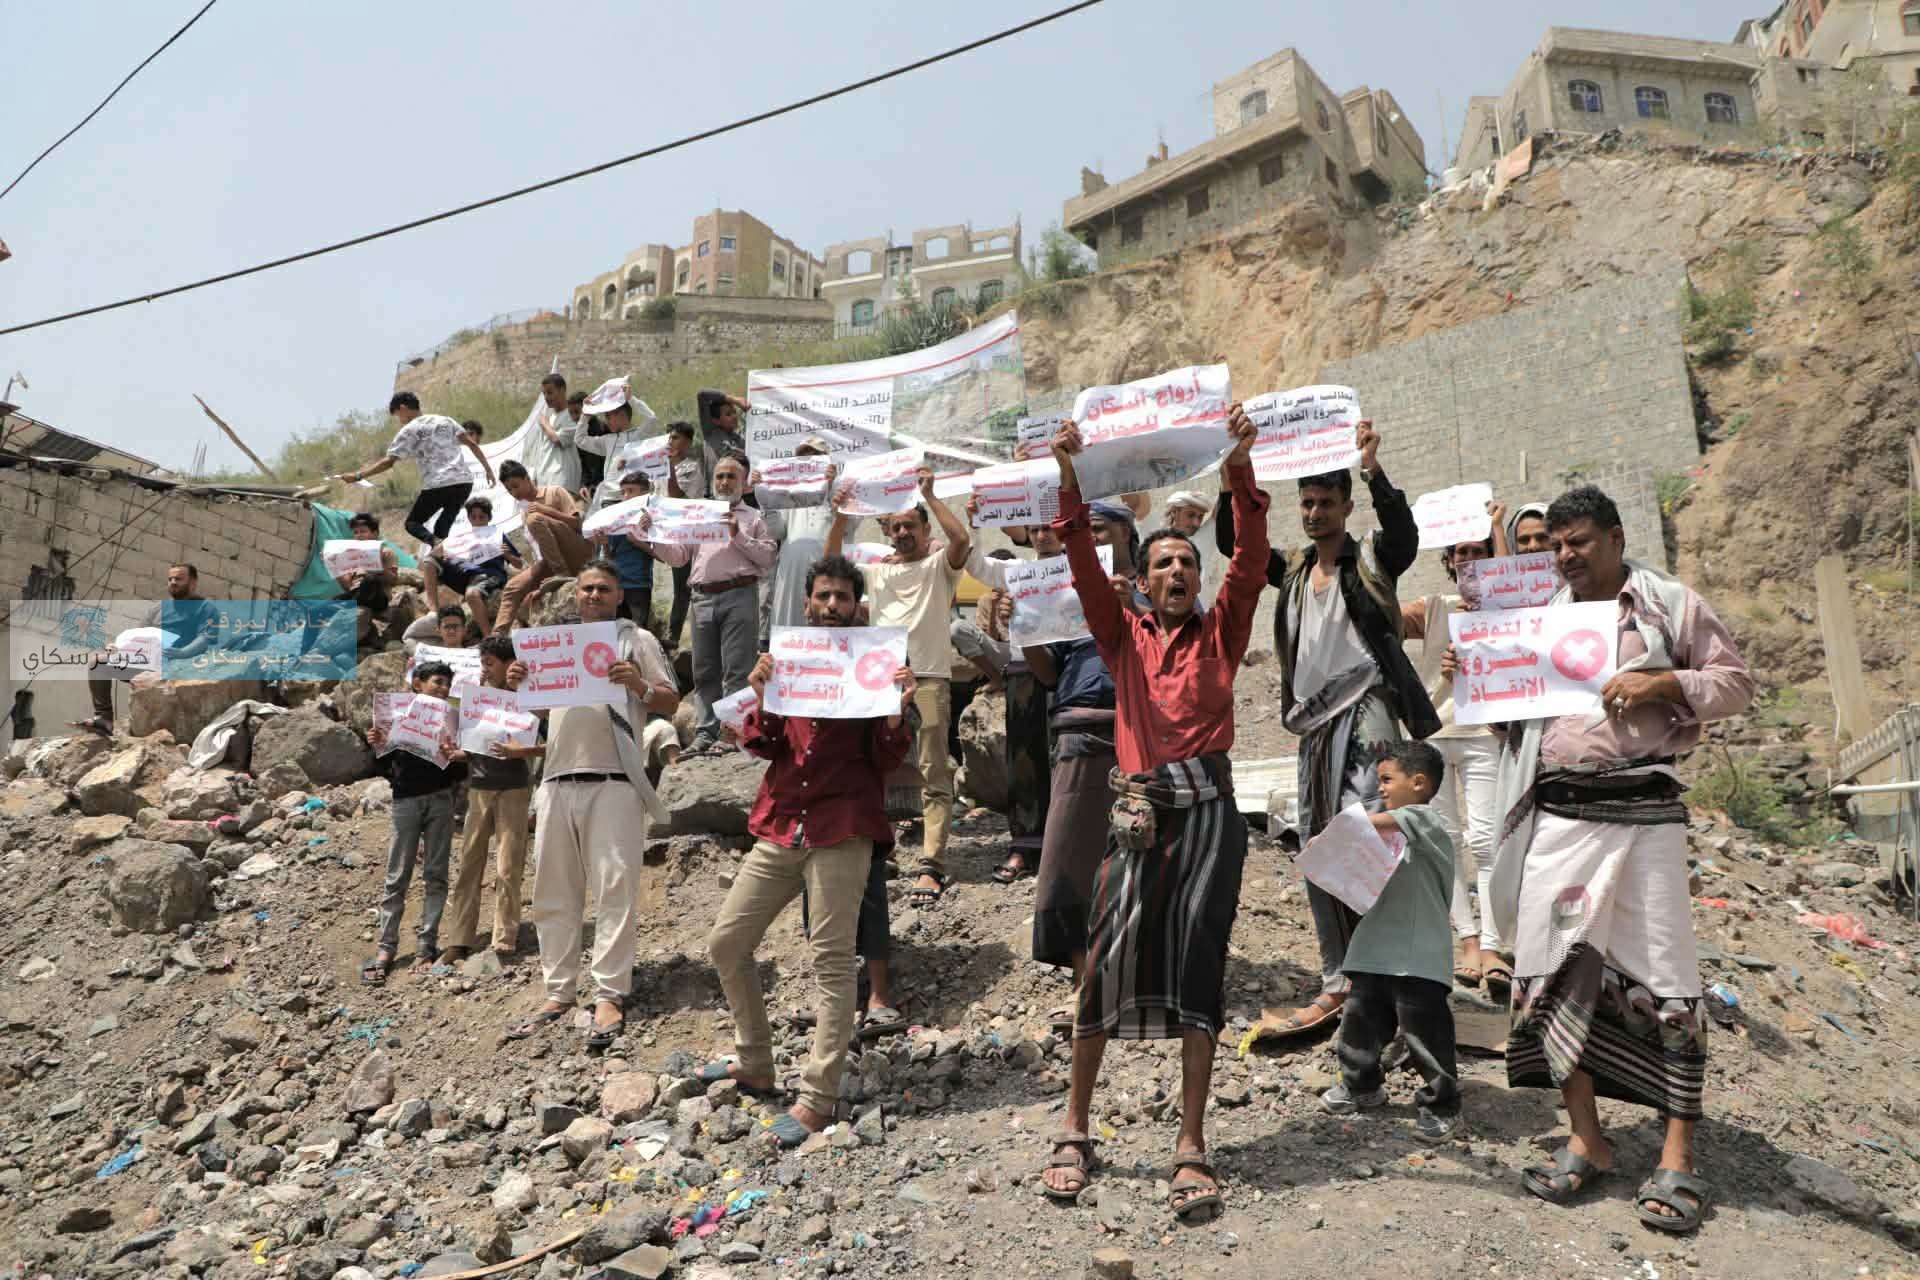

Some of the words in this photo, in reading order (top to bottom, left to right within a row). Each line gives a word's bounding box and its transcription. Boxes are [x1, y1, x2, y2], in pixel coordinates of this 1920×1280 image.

[1530, 617, 1543, 636] لا
[565, 631, 575, 646] لا
[840, 636, 849, 652] لا
[528, 653, 575, 674] مشرو
[776, 659, 844, 677] مشروع
[1460, 644, 1538, 677] مشروع
